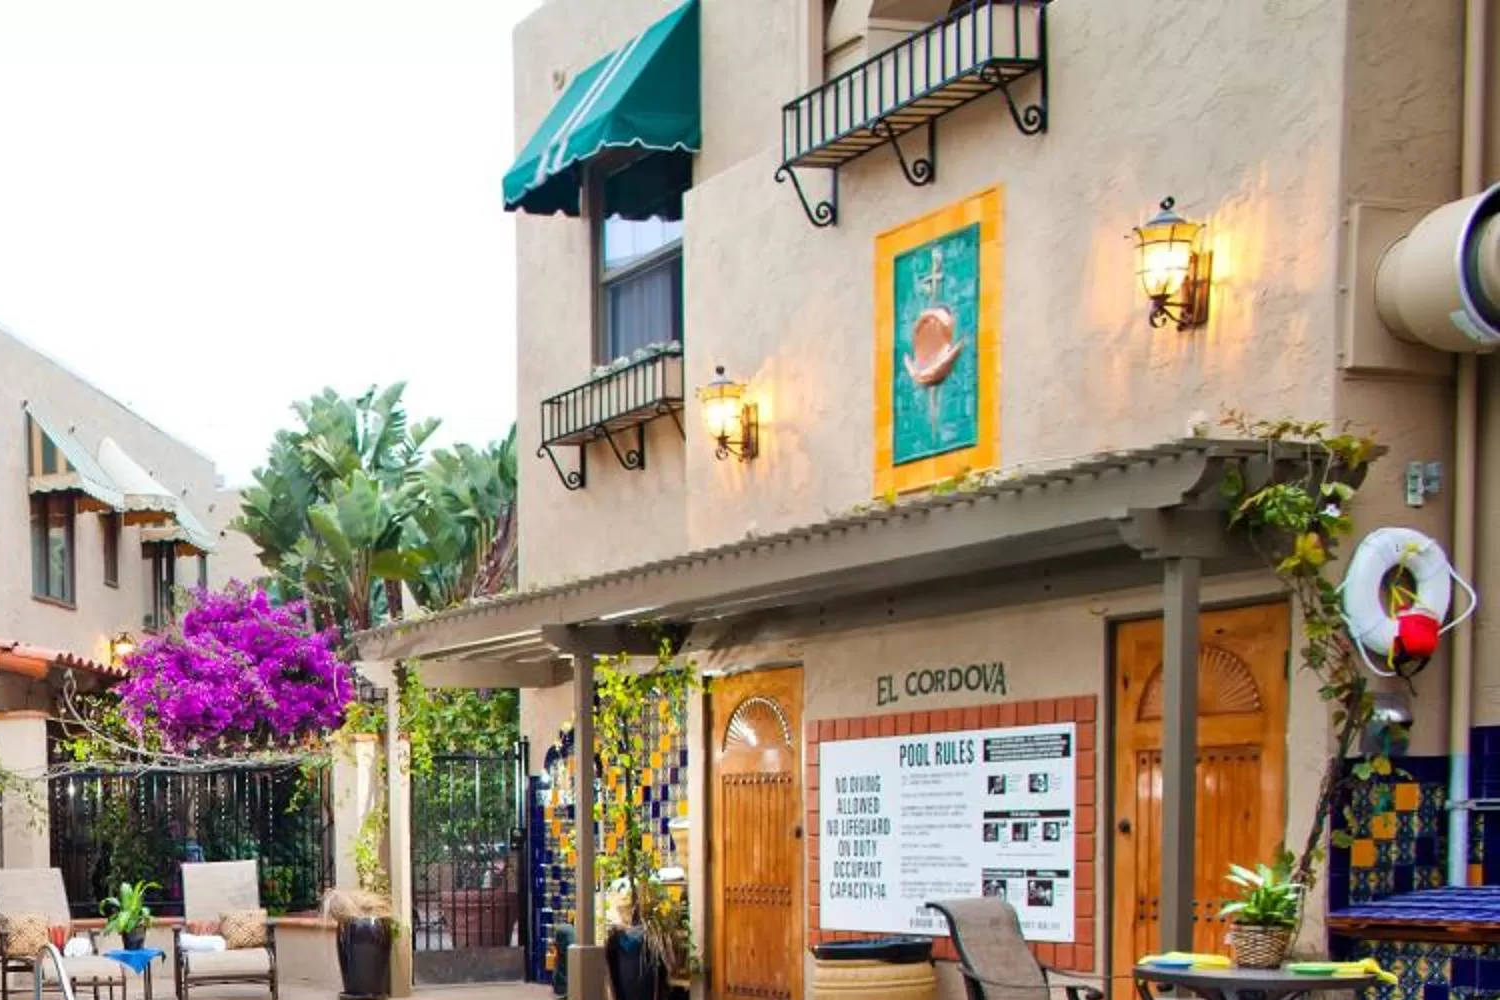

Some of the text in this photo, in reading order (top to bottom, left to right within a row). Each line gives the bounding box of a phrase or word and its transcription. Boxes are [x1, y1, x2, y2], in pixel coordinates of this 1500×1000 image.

[877, 662, 1006, 705] EL CORDOVA
[900, 743, 930, 767] POOL
[936, 740, 975, 765] RULES
[837, 797, 880, 814] ALLOWED
[826, 820, 839, 836] NO
[842, 818, 890, 835] LIFEGUARD
[833, 861, 882, 878] OCCUPANT
